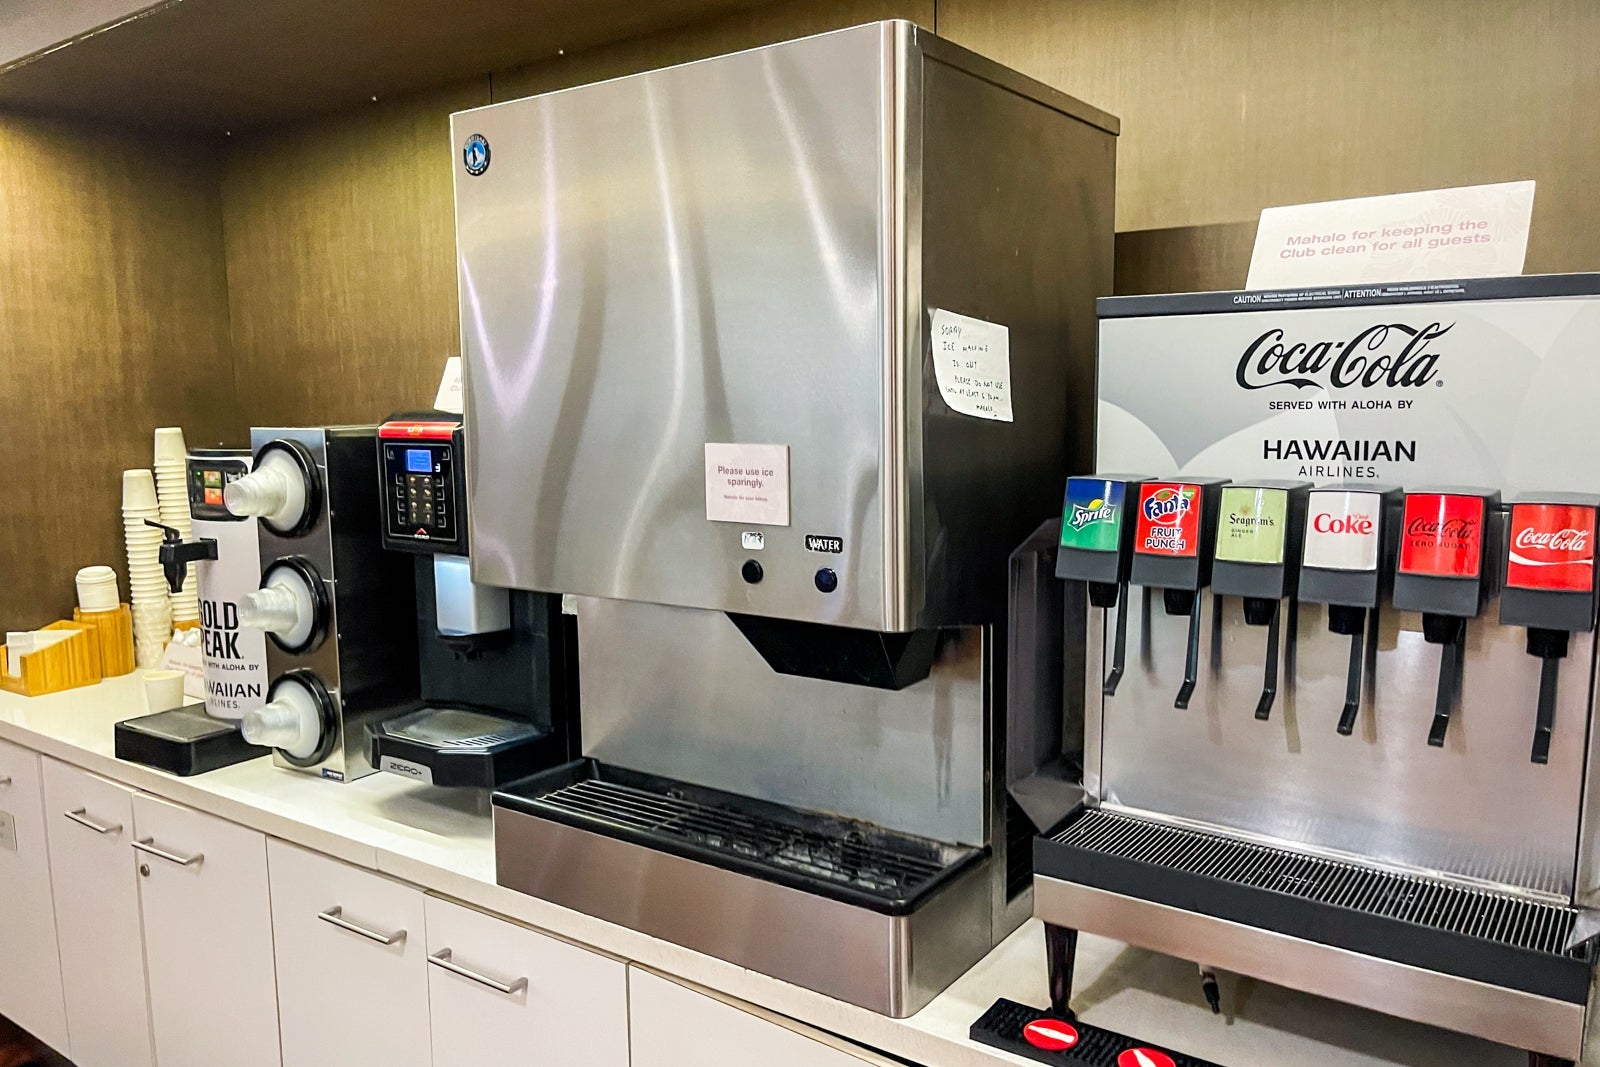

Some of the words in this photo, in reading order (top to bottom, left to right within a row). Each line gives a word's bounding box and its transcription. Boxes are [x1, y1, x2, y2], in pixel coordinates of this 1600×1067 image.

[1286, 232, 1345, 246] Mahalo
[1351, 229, 1377, 240] for
[1381, 223, 1453, 238] keeping
[1458, 220, 1488, 230] the
[1279, 247, 1316, 259] Club
[1320, 244, 1367, 257] clean
[1372, 240, 1397, 252] for
[1402, 238, 1422, 249] all
[1428, 233, 1491, 250] guests
[1233, 295, 1262, 304] CAUTION
[1343, 288, 1382, 299] ATTENTION
[1236, 322, 1456, 389] Coca-Cola
[1269, 401, 1313, 410] SERVED
[1318, 400, 1347, 410] WITH
[1351, 400, 1392, 410] ALOHA
[1398, 400, 1413, 409] BY
[1263, 439, 1416, 462] HAWAIIAN
[717, 465, 743, 477] Please
[745, 468, 760, 477] use
[761, 468, 774, 477] ice
[727, 478, 764, 489] sparingly.
[1072, 507, 1111, 527] Sprite
[1144, 495, 1189, 522] Fanta
[1151, 527, 1182, 538] FRUIT
[1313, 513, 1373, 535] Coke
[1408, 517, 1476, 540] Coca-Cola
[808, 537, 840, 551] WATER
[1145, 539, 1186, 550] PUNCH
[1516, 527, 1591, 551] Coca-Cola
[222, 663, 246, 671] ALOHA
